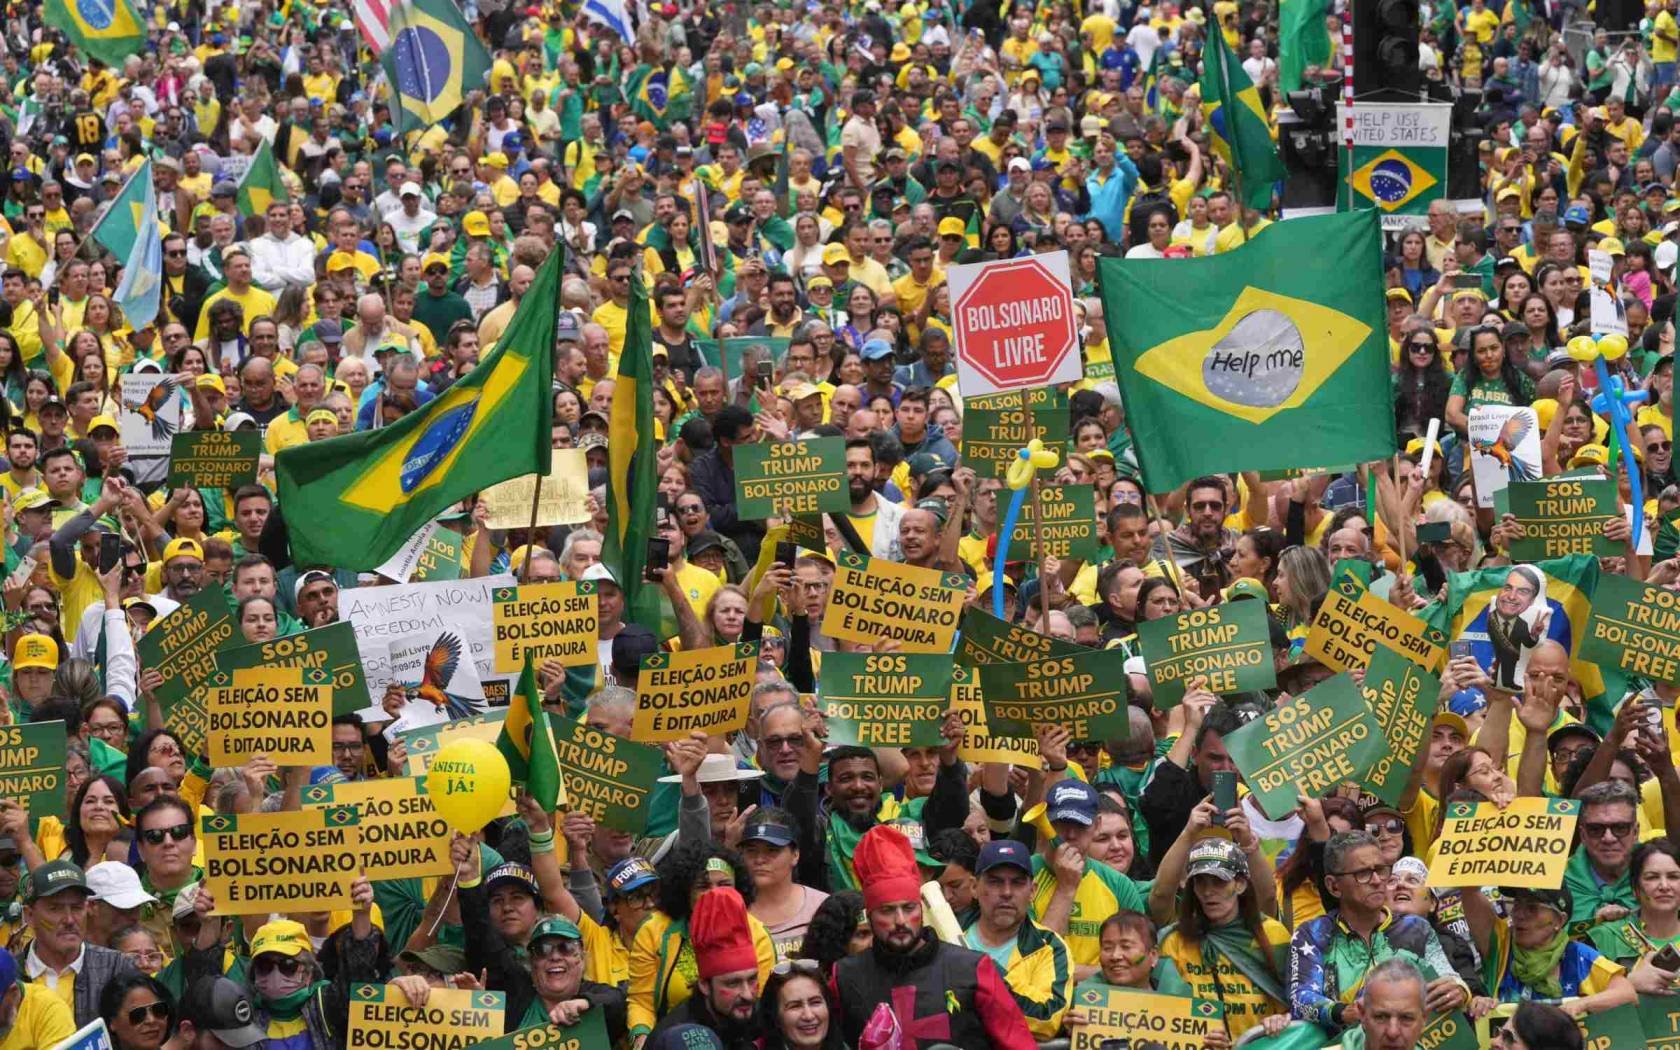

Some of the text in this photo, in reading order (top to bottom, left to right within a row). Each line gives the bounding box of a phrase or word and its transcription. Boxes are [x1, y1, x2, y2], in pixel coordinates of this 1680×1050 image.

[75, 115, 99, 145] 18
[1390, 127, 1439, 142] STATES
[967, 295, 1063, 332] BOLSONARO
[992, 333, 1048, 369] LIVRE
[1210, 349, 1304, 378] Help me
[201, 432, 232, 444] SOS
[770, 442, 808, 458] SOS
[191, 445, 241, 457] TRUMP
[174, 461, 252, 473] BOLSONARO
[760, 457, 822, 475] TRUMP
[194, 473, 232, 486] FREE
[744, 478, 840, 499] BOLSONARO
[1547, 482, 1584, 497] SOS
[772, 495, 818, 514] FREE
[1536, 498, 1597, 516] TRUMP
[1546, 537, 1593, 556] FREE
[846, 570, 953, 604] ELEIÇÃO SEM
[348, 591, 427, 620] AMNESTY
[503, 597, 590, 619] ELEIÇÃO SEM
[832, 589, 955, 626] BOLSONARO
[1627, 601, 1680, 633] TRUM
[162, 603, 193, 635] SOS
[496, 616, 596, 641] BOLSONARO
[842, 612, 936, 645] É DITADURA
[1177, 607, 1221, 631] SOS
[1335, 599, 1432, 658] ELEIÇÃO SEM
[159, 610, 209, 655] TRUMP
[1008, 627, 1053, 651] SOS
[1168, 624, 1238, 653] TRUMP
[261, 635, 309, 660] SOS
[408, 643, 431, 655] Livre
[511, 644, 519, 660] É
[1322, 637, 1333, 655] É
[650, 661, 747, 688] ELEIÇÃO SEM
[866, 655, 906, 673] SOS
[1027, 658, 1075, 679] SOS
[1154, 649, 1263, 684] BOLSONARO
[1620, 648, 1678, 681] FREE
[218, 683, 279, 709] ELEIÇÃO
[283, 687, 319, 704] SEM
[639, 681, 751, 710] BOLSONARO
[852, 674, 923, 695] TRUMP
[1014, 674, 1094, 699] TRUMP
[210, 710, 328, 731] BOLSONARO
[653, 707, 737, 731] É DITADURA
[827, 702, 940, 721] BOLSONARO
[995, 698, 1117, 721] BOLSONARO
[1264, 697, 1311, 734] SOS
[0, 727, 22, 746] OS
[572, 725, 618, 754] SOS
[857, 722, 913, 744] FREE
[1262, 706, 1335, 758] TRUMP
[1371, 676, 1422, 787] BOLSONARO
[1397, 709, 1428, 768] FREE
[223, 735, 315, 754] É DITADURA
[431, 760, 476, 775] ANISTIA
[558, 739, 629, 778] TRUMP
[1257, 722, 1369, 794] BOLSONARO
[446, 775, 475, 795] JÁ!
[1294, 752, 1355, 798] FREE
[398, 799, 437, 815] SEM
[1454, 811, 1563, 835] ELEIÇÃO SEM
[218, 828, 345, 855] ELEIÇÃO SEM
[1438, 836, 1567, 856] BOLSONARO
[208, 852, 356, 878] BOLSONARO
[1448, 858, 1547, 876] É DITADURA
[229, 881, 344, 901] É DITADURA
[449, 1009, 490, 1027] SEM
[1088, 1009, 1208, 1035] ELEIÇÃO SEM
[512, 1024, 561, 1050] SOS
